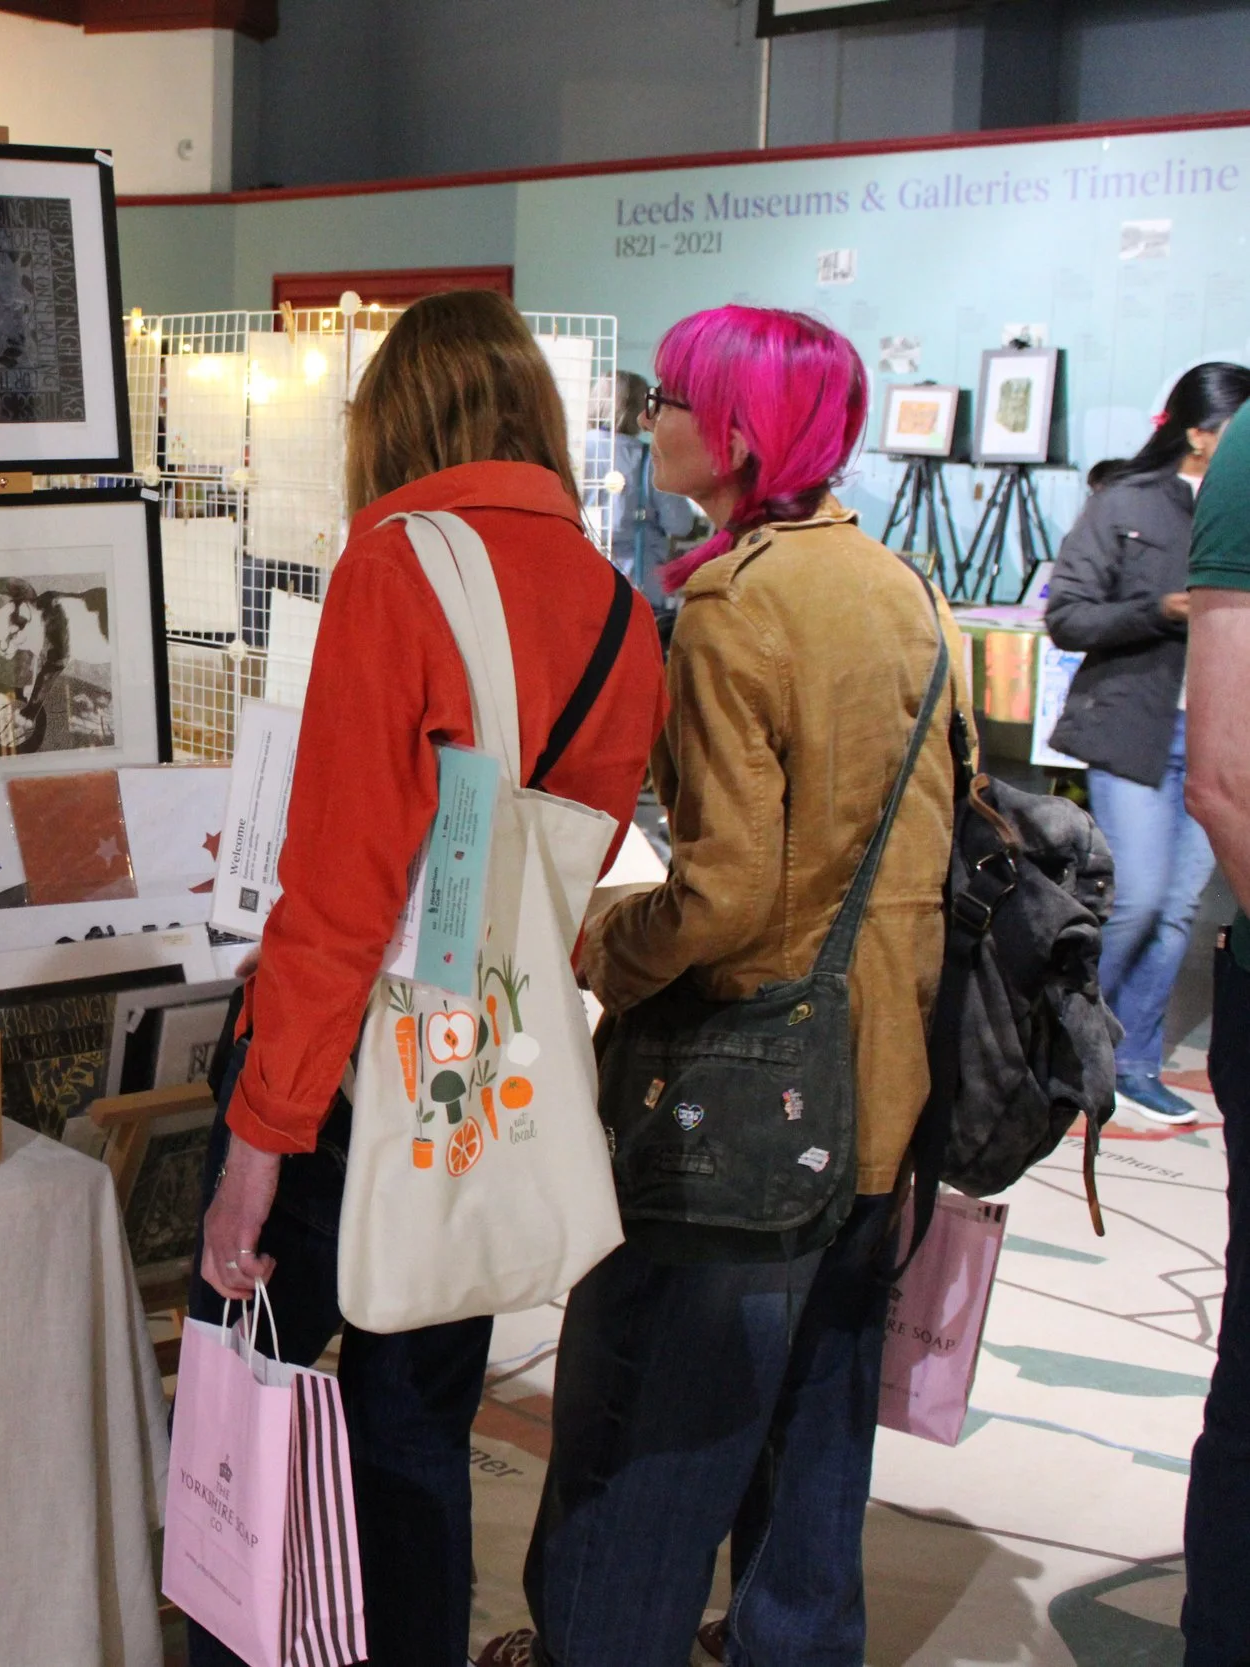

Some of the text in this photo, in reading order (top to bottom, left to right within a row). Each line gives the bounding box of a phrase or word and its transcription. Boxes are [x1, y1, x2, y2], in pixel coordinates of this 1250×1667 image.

[616, 158, 1240, 227] Leeds Museums & Galleries Timeline
[229, 816, 247, 876] Welcome
[509, 1119, 538, 1146] local
[912, 1327, 956, 1351] SOAP
[180, 1468, 259, 1549] YORKSHIRE SOAP
[215, 1480, 231, 1501] THE
